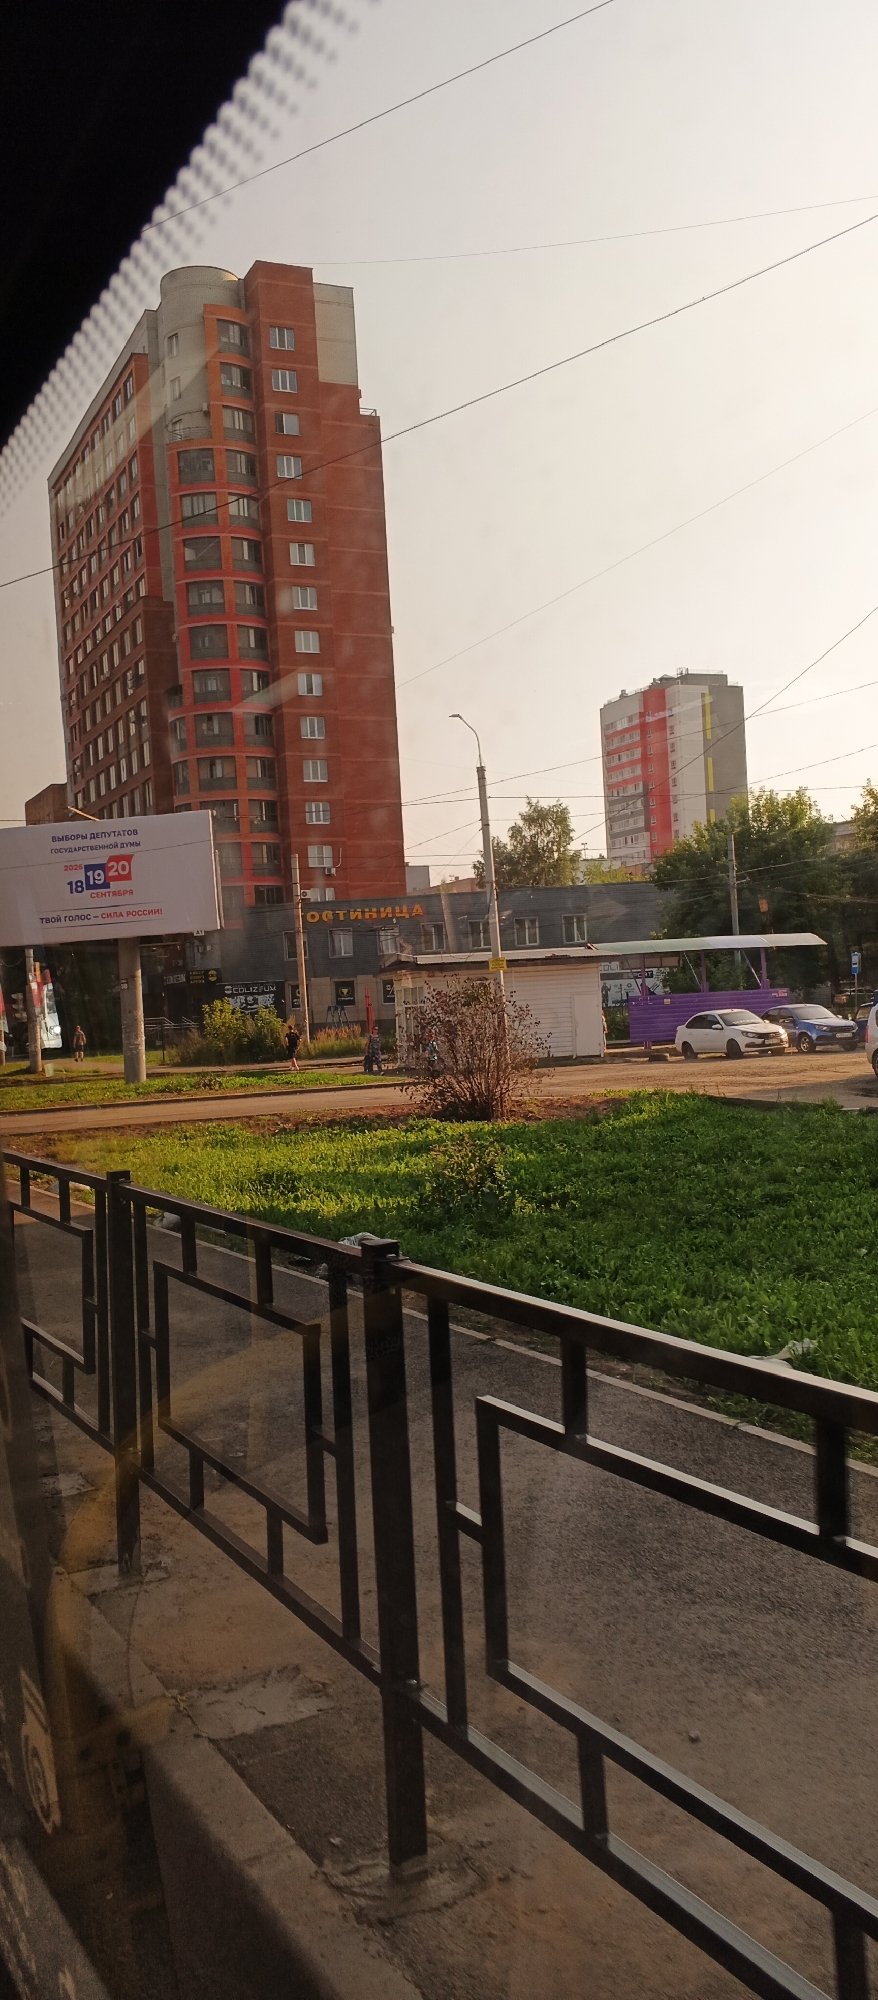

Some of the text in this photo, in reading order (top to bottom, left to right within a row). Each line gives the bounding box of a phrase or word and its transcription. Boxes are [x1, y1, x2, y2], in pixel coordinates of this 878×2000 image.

[51, 829, 139, 842] ВЫБОРЫ ДЕПУТАТОВ
[50, 840, 141, 854] ГОСУДАРСТВЕННОЙ ДУМЫ
[63, 864, 84, 872] 2026
[66, 860, 130, 895] 18 19 20
[89, 889, 134, 899] СЕНТЯБРЯ
[39, 915, 62, 924] ТВОЙ
[63, 913, 92, 922] ГОЛОС
[100, 911, 124, 920] СИЛА
[125, 908, 163, 918] РОССИИ!
[301, 903, 424, 923] ОСТИНИЦА
